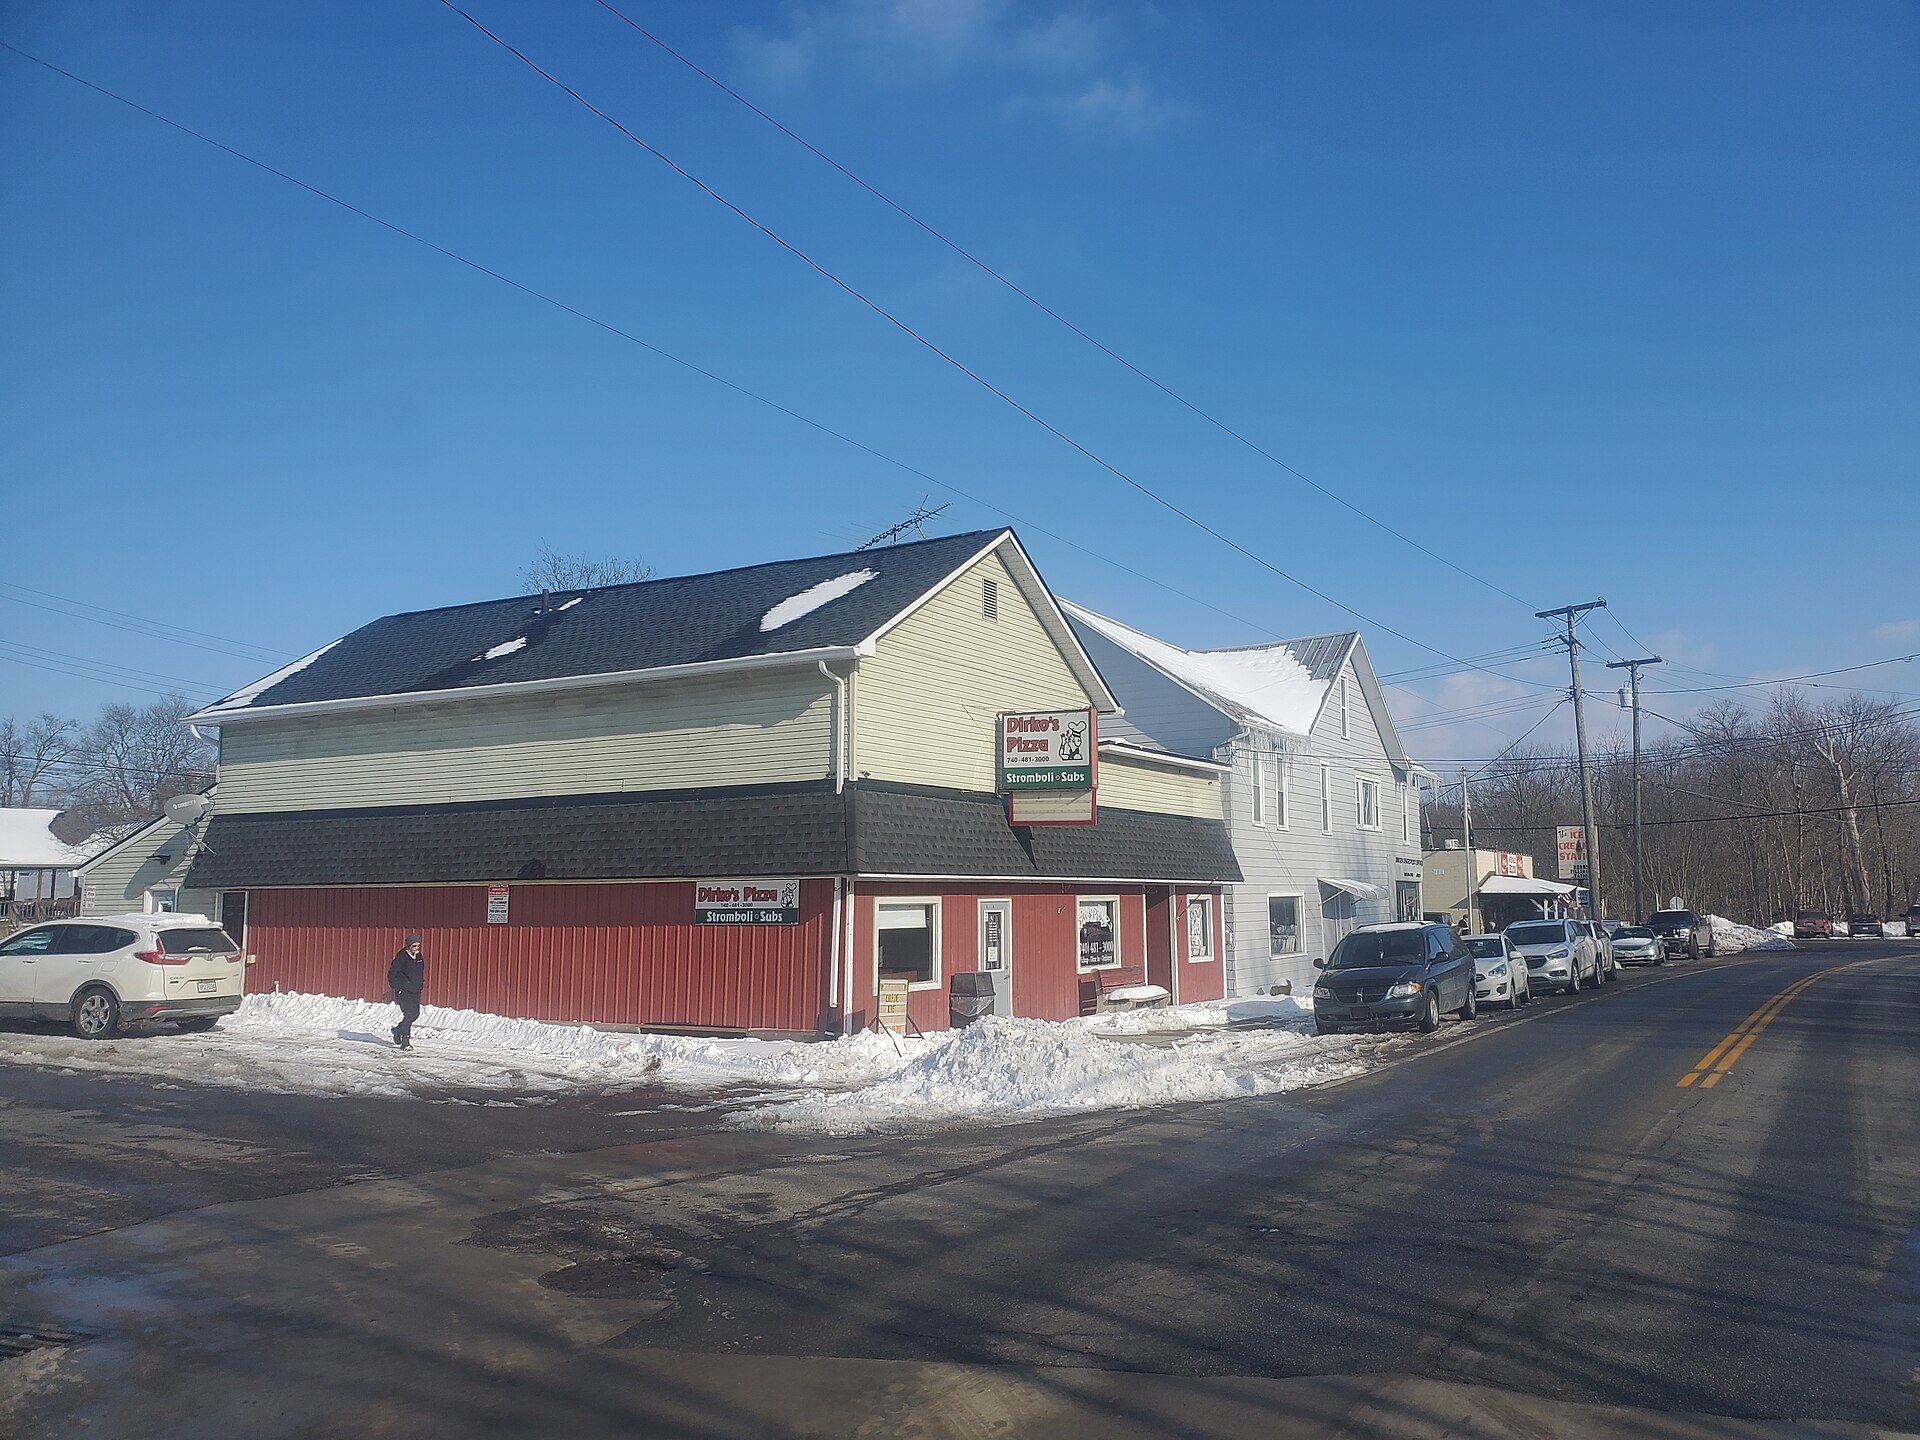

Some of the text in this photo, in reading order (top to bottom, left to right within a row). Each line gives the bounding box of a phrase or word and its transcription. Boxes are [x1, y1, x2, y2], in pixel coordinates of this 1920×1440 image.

[1007, 736, 1049, 753] Pizza
[1006, 771, 1085, 783] Stromboli Subs
[1570, 831, 1583, 839] ICE
[1559, 842, 1588, 850] CREM
[743, 886, 778, 901] Pizza
[706, 911, 783, 922] Stromboli Subs
